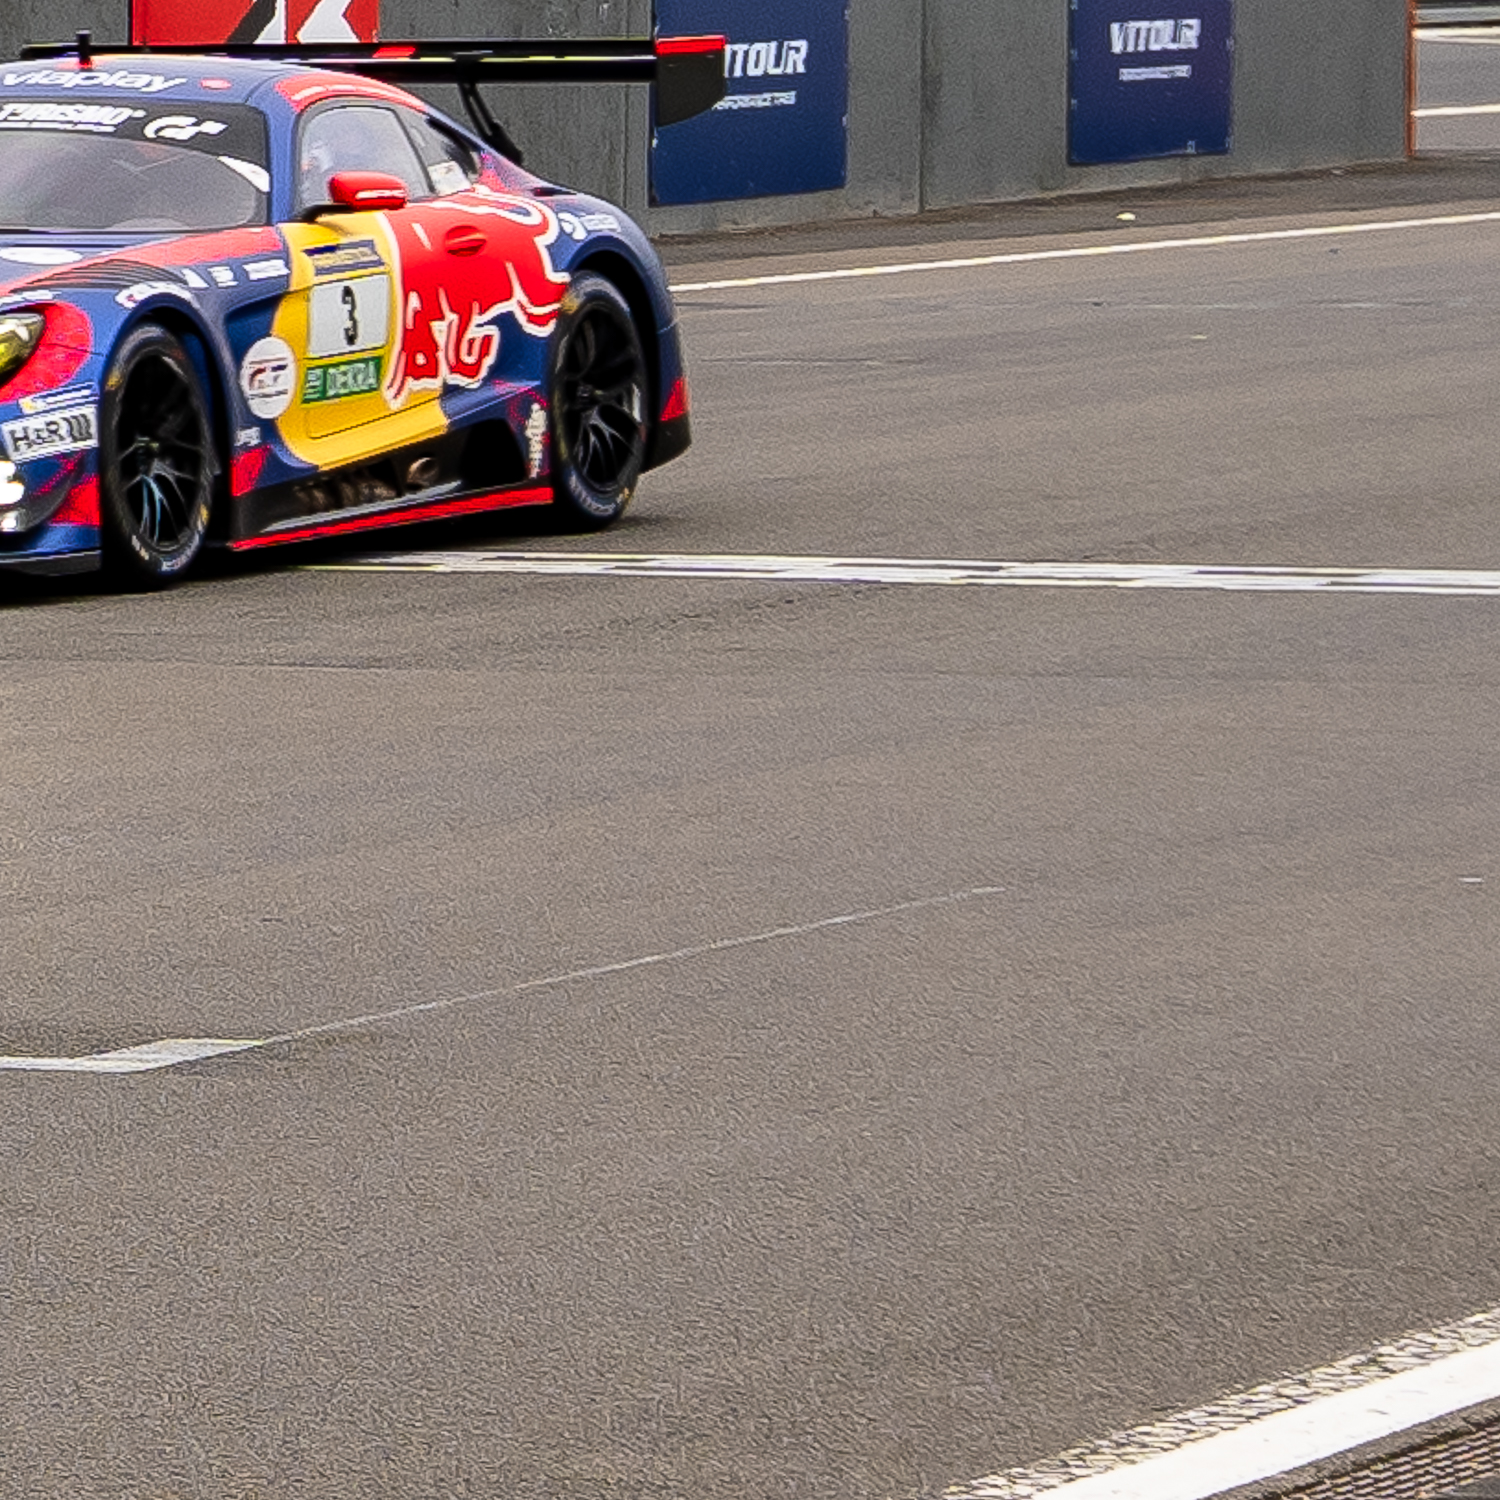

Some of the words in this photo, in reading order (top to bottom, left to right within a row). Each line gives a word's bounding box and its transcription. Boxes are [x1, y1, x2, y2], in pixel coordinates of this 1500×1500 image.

[724, 38, 809, 79] ITOUR
[2, 69, 189, 93] viaplay
[341, 285, 359, 346] 3
